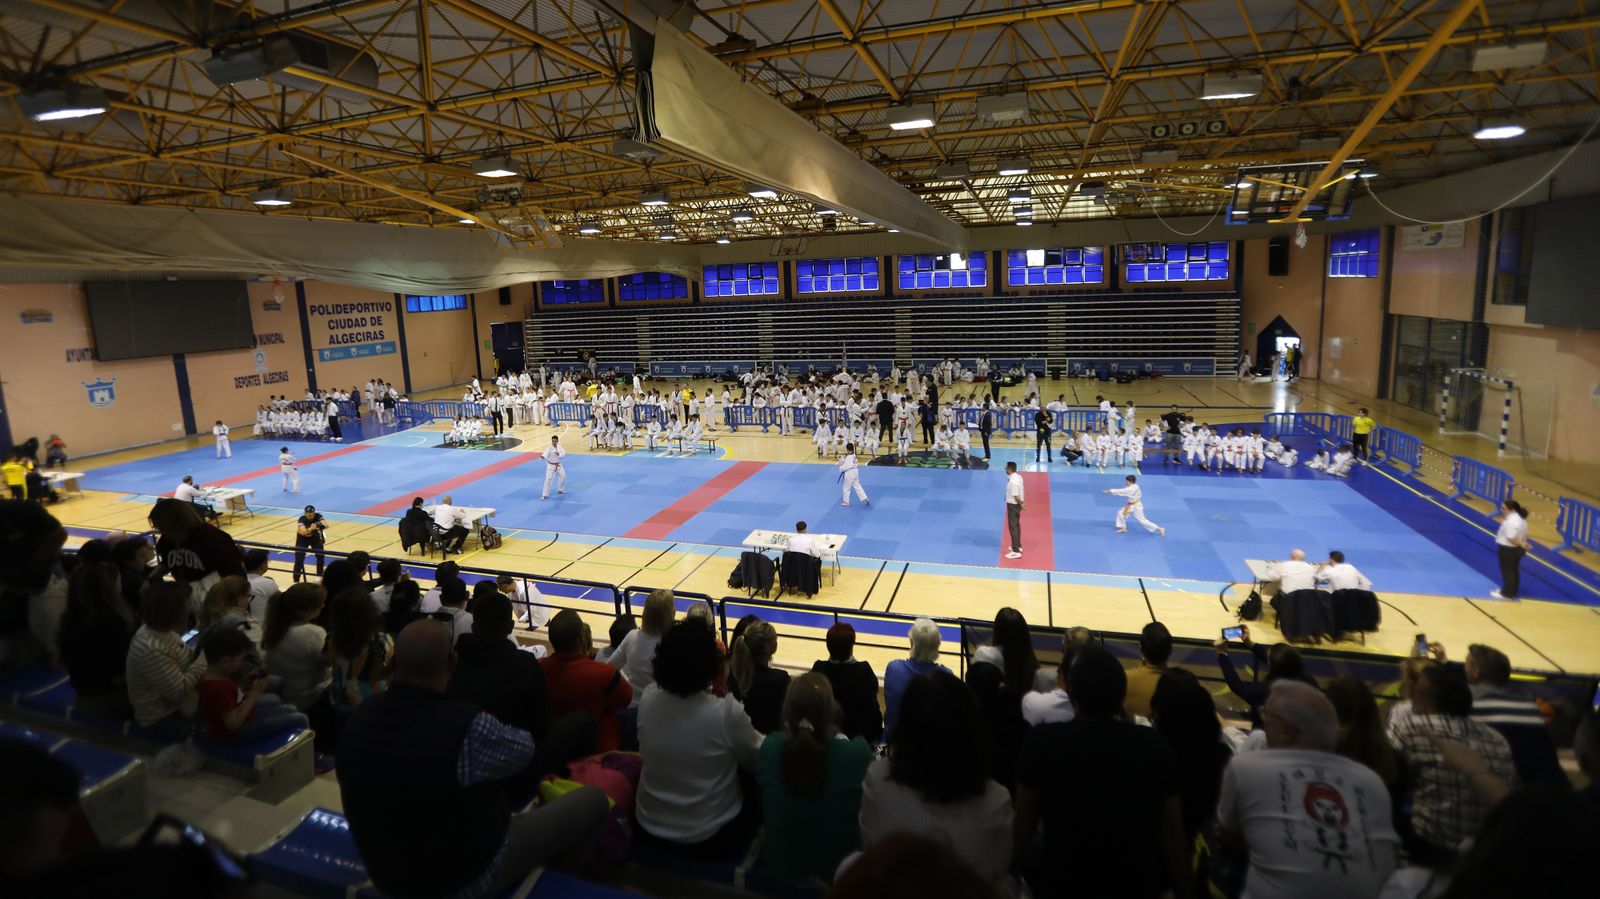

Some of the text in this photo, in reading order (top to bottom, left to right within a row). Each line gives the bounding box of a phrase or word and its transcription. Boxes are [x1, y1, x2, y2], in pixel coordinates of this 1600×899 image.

[310, 302, 392, 316] POLIDEPORTIVO
[328, 316, 383, 330] CIUDAD DE
[329, 330, 385, 345] ALGECIRAS
[234, 370, 289, 389] DEPORTES ALGECIRAS
